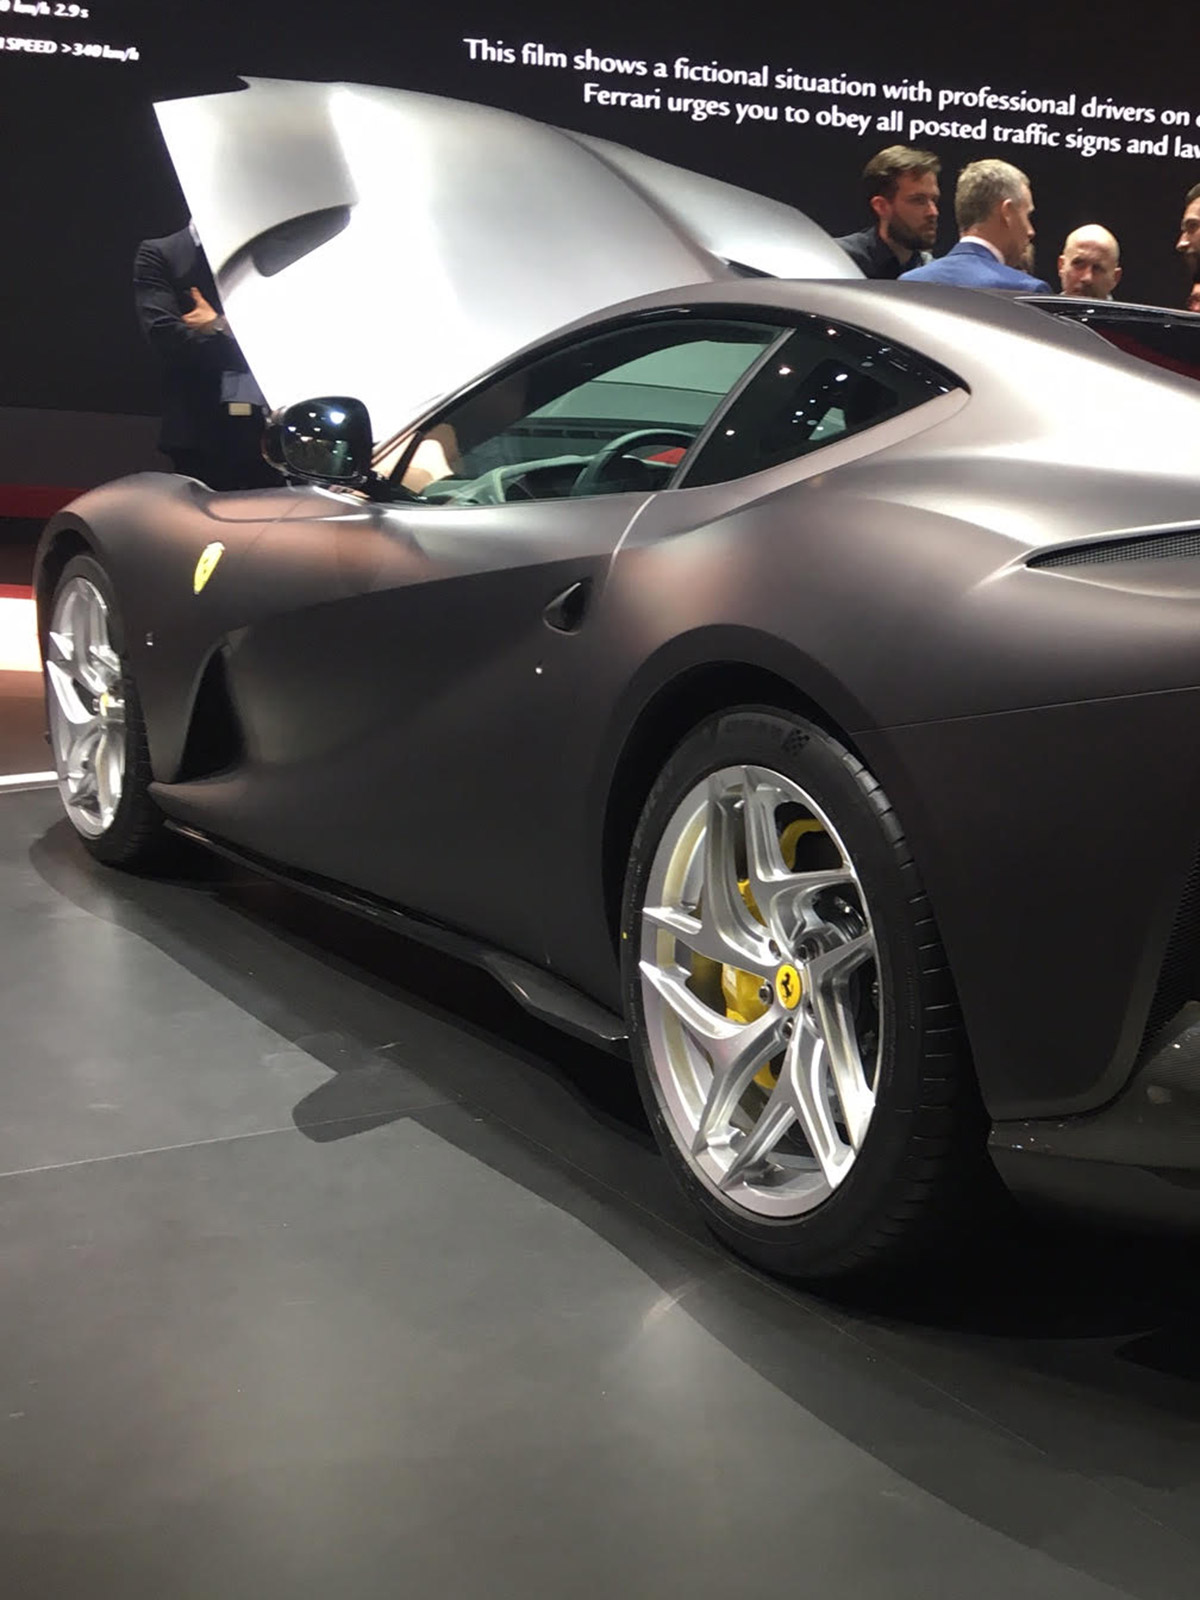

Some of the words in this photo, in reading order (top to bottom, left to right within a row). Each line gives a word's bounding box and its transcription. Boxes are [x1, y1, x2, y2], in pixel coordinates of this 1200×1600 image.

[5, 37, 58, 54] SPEED
[463, 38, 517, 64] This
[521, 42, 567, 68] film
[573, 48, 648, 76] shows
[653, 62, 669, 78] a
[673, 56, 769, 88] fictional
[774, 67, 876, 98] situation
[882, 78, 932, 103] with
[938, 85, 1076, 116] professional
[1081, 95, 1155, 124] drivers
[1160, 109, 1190, 127] on
[583, 82, 661, 110] Ferrari
[667, 93, 730, 121] urges
[735, 102, 778, 125] you
[784, 105, 810, 124] to
[815, 105, 871, 135] obey
[876, 109, 904, 132] all
[909, 109, 987, 141] posted
[992, 122, 1061, 147] traffic
[1065, 127, 1121, 157] signs
[1126, 134, 1169, 156] and
